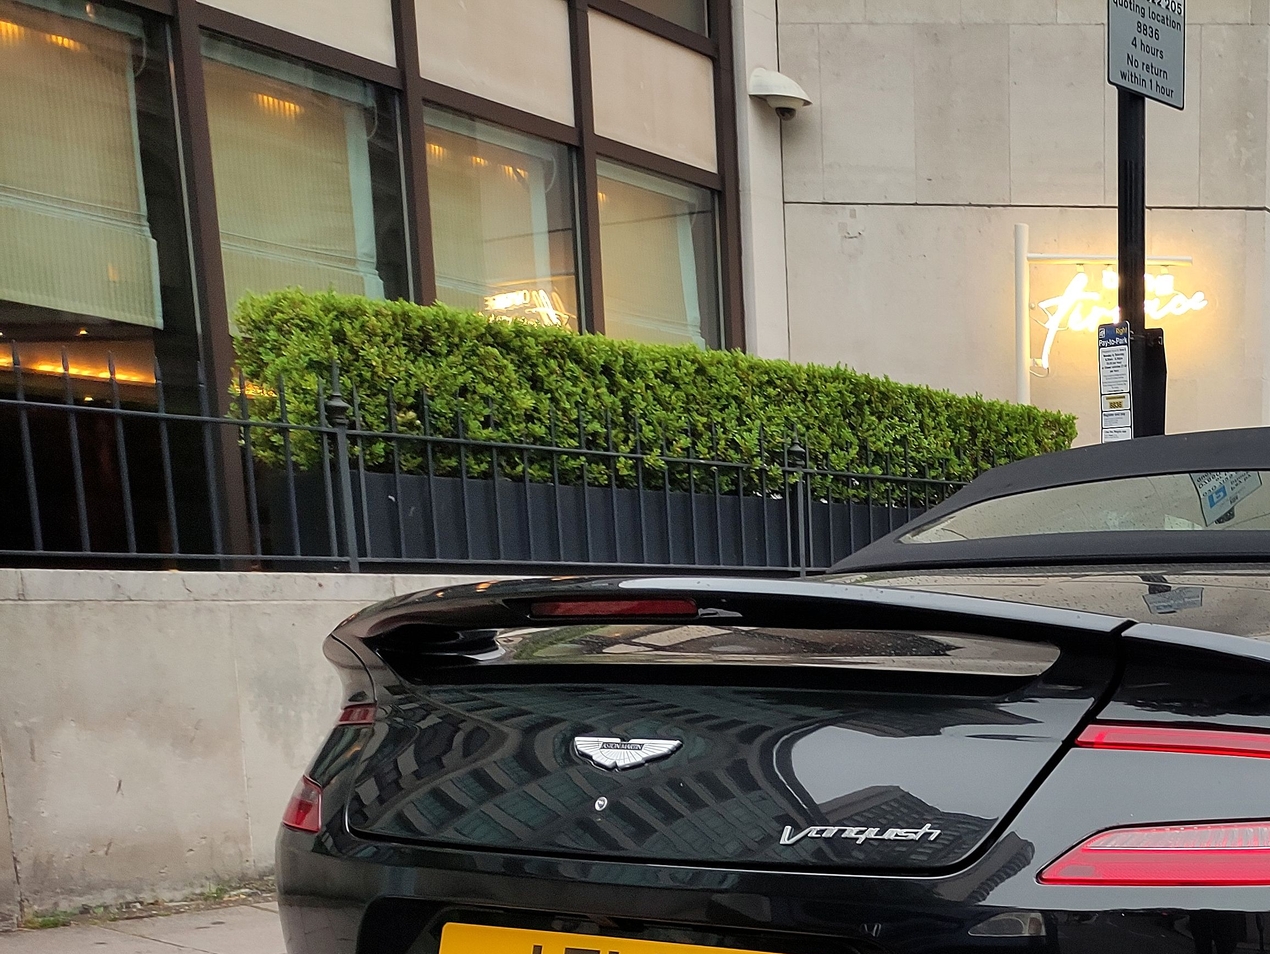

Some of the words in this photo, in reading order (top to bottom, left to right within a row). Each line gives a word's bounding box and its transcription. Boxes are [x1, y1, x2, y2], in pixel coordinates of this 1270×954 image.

[1113, 0, 1146, 18] quoting
[1148, 6, 1182, 31] location
[1136, 21, 1160, 41] 8836
[1131, 37, 1138, 49] 4
[1140, 39, 1164, 60] hours
[1126, 53, 1139, 68] No
[1142, 61, 1168, 80] return
[1120, 70, 1147, 88] within
[1149, 79, 1153, 91] 1
[1155, 81, 1174, 98] hour
[780, 823, 941, 845] Vanquish
